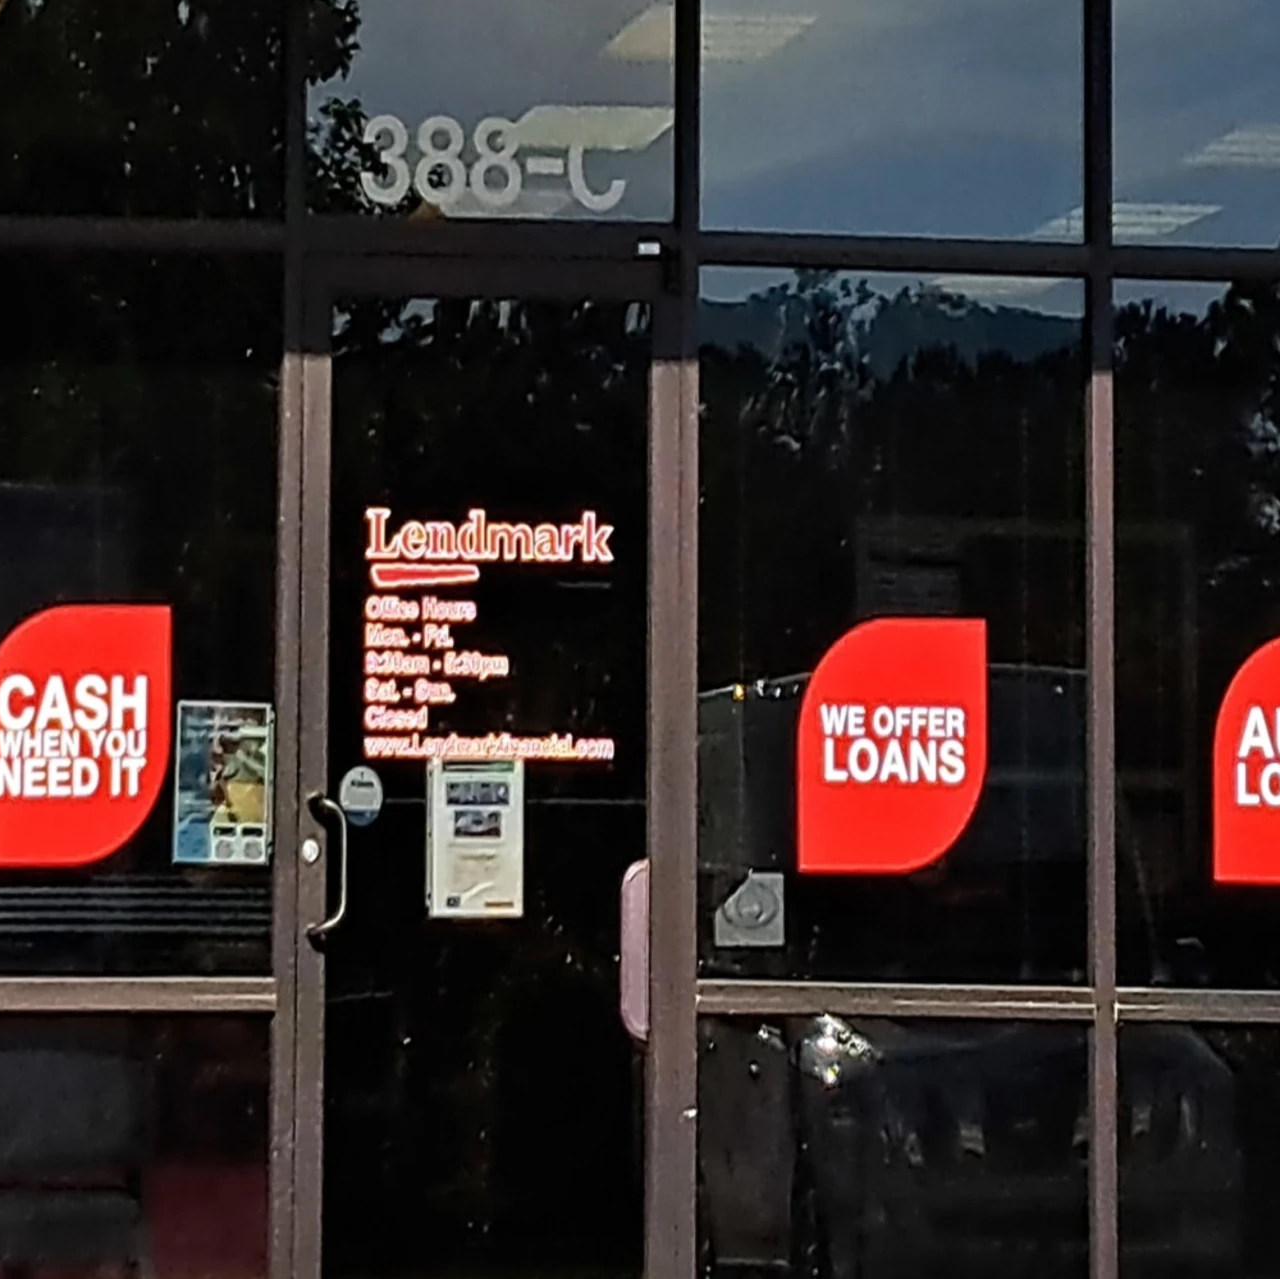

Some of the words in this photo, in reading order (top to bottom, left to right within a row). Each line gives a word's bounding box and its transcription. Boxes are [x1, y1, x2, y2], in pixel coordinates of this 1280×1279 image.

[361, 114, 626, 212] 388-C
[365, 507, 615, 562] Lendmark
[365, 596, 420, 620] Office
[422, 597, 477, 621] Hours
[364, 705, 429, 730] Closed
[820, 703, 866, 736] WE
[873, 705, 966, 738] OFFER
[87, 728, 148, 759] YOU
[824, 737, 966, 783] LOANS
[110, 758, 148, 797] IT
